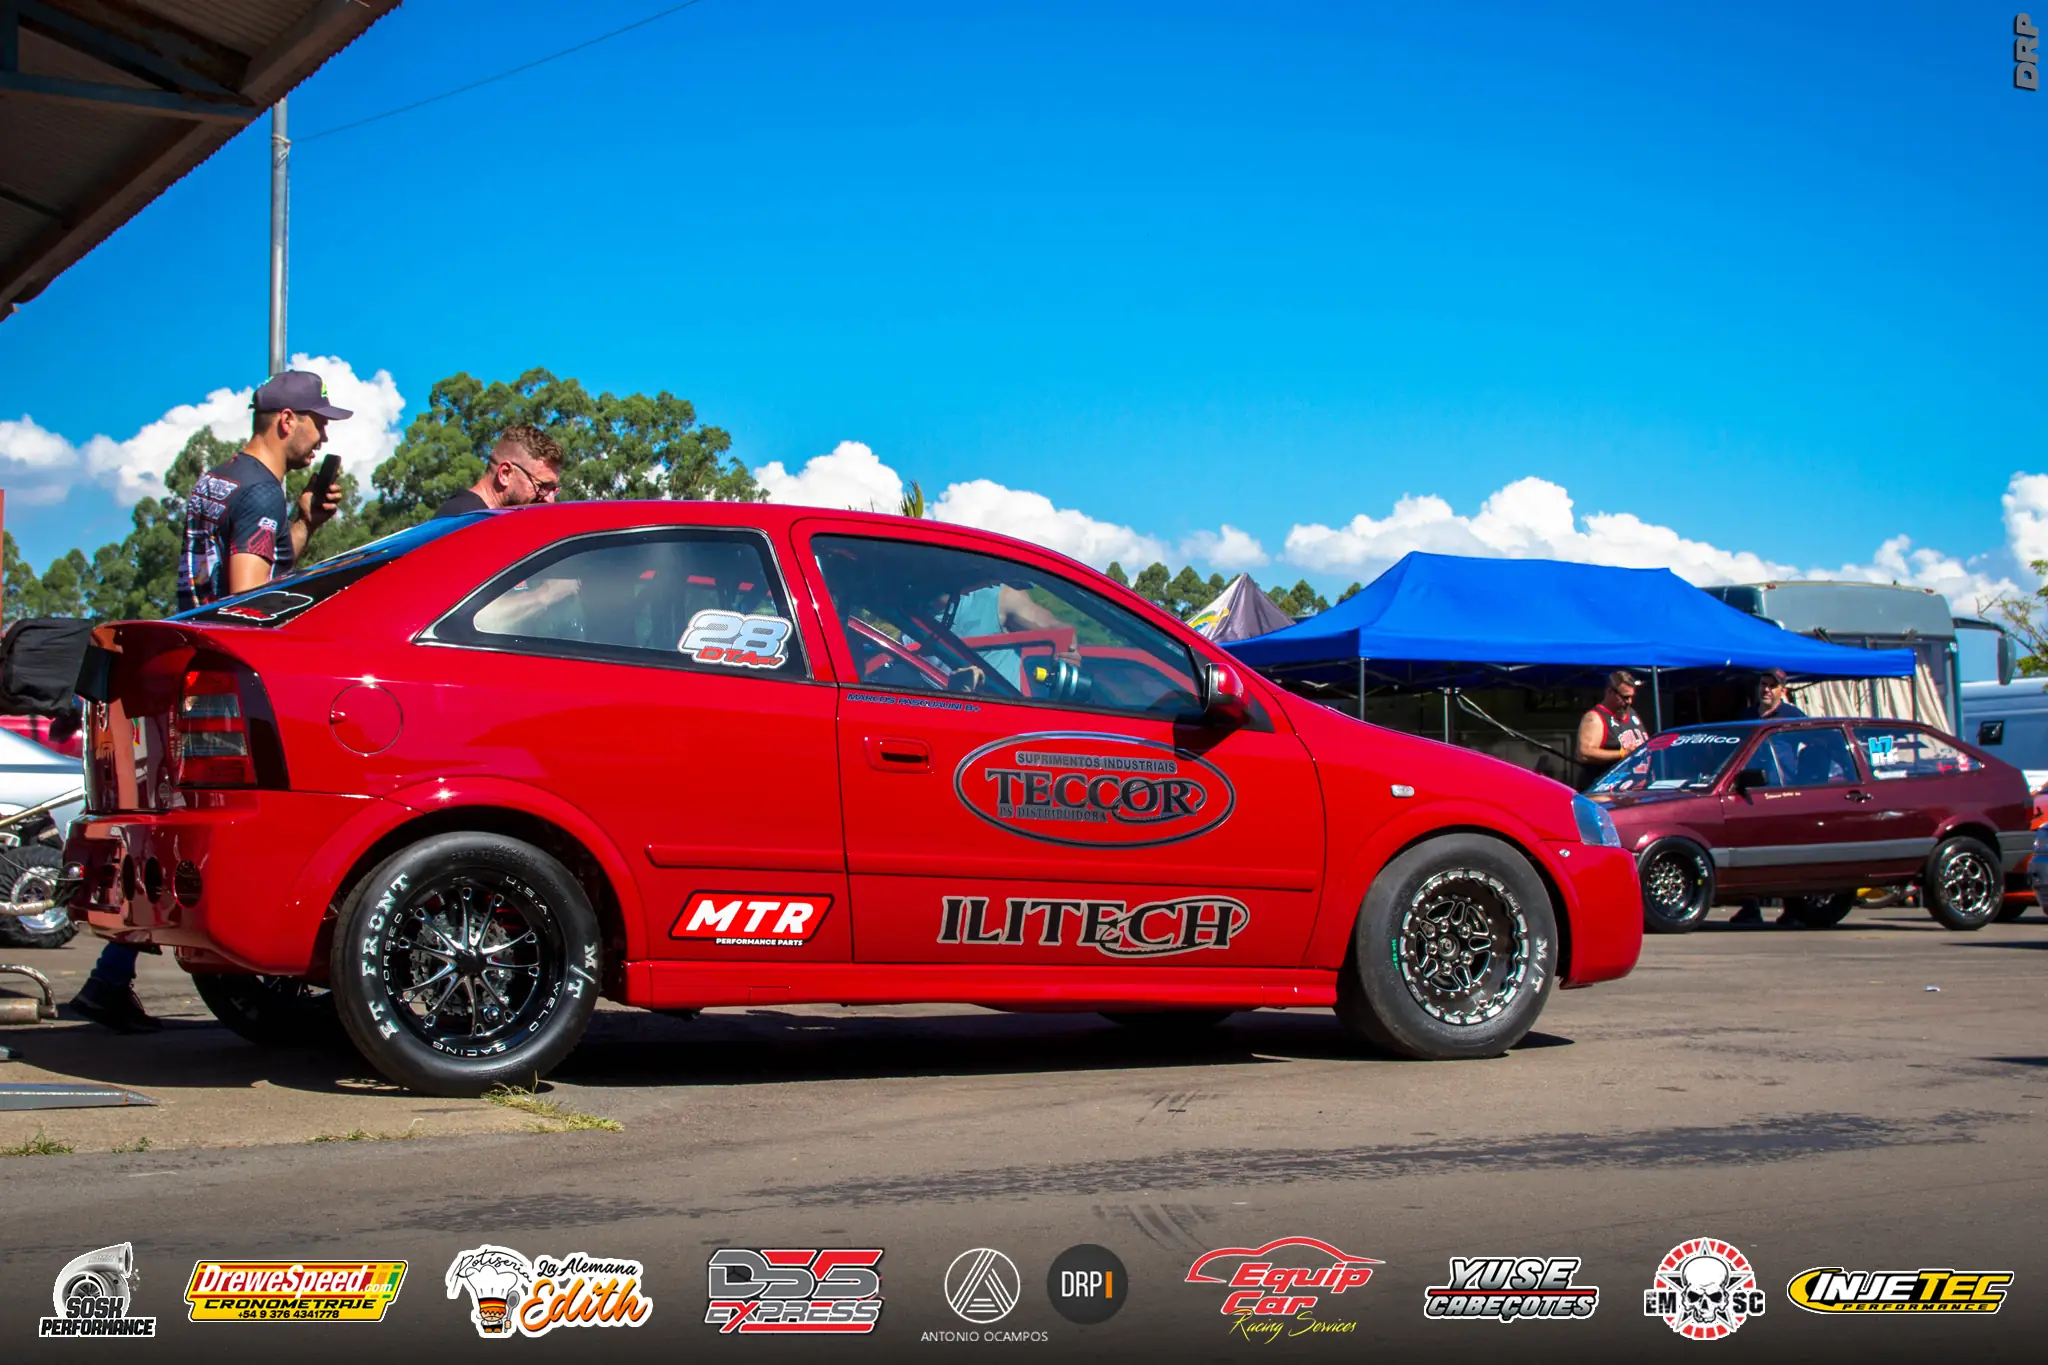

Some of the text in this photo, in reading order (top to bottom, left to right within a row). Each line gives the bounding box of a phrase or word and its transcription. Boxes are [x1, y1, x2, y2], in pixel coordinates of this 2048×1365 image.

[680, 612, 789, 654] 28
[847, 693, 896, 704] MARCOS
[1017, 752, 1176, 773] SUPRIMENTOS INDUSTRIAIS
[985, 768, 1205, 819] TECCOR
[1018, 807, 1108, 822] DISTRIBUIDORA
[361, 873, 408, 977] FRONT
[686, 900, 814, 933] MTR
[937, 896, 1248, 958] ILITECH
[382, 912, 403, 996] FORGED
[567, 944, 598, 999] M/T
[1530, 938, 1548, 993] M/T
[432, 981, 561, 1057] WELD RACING
